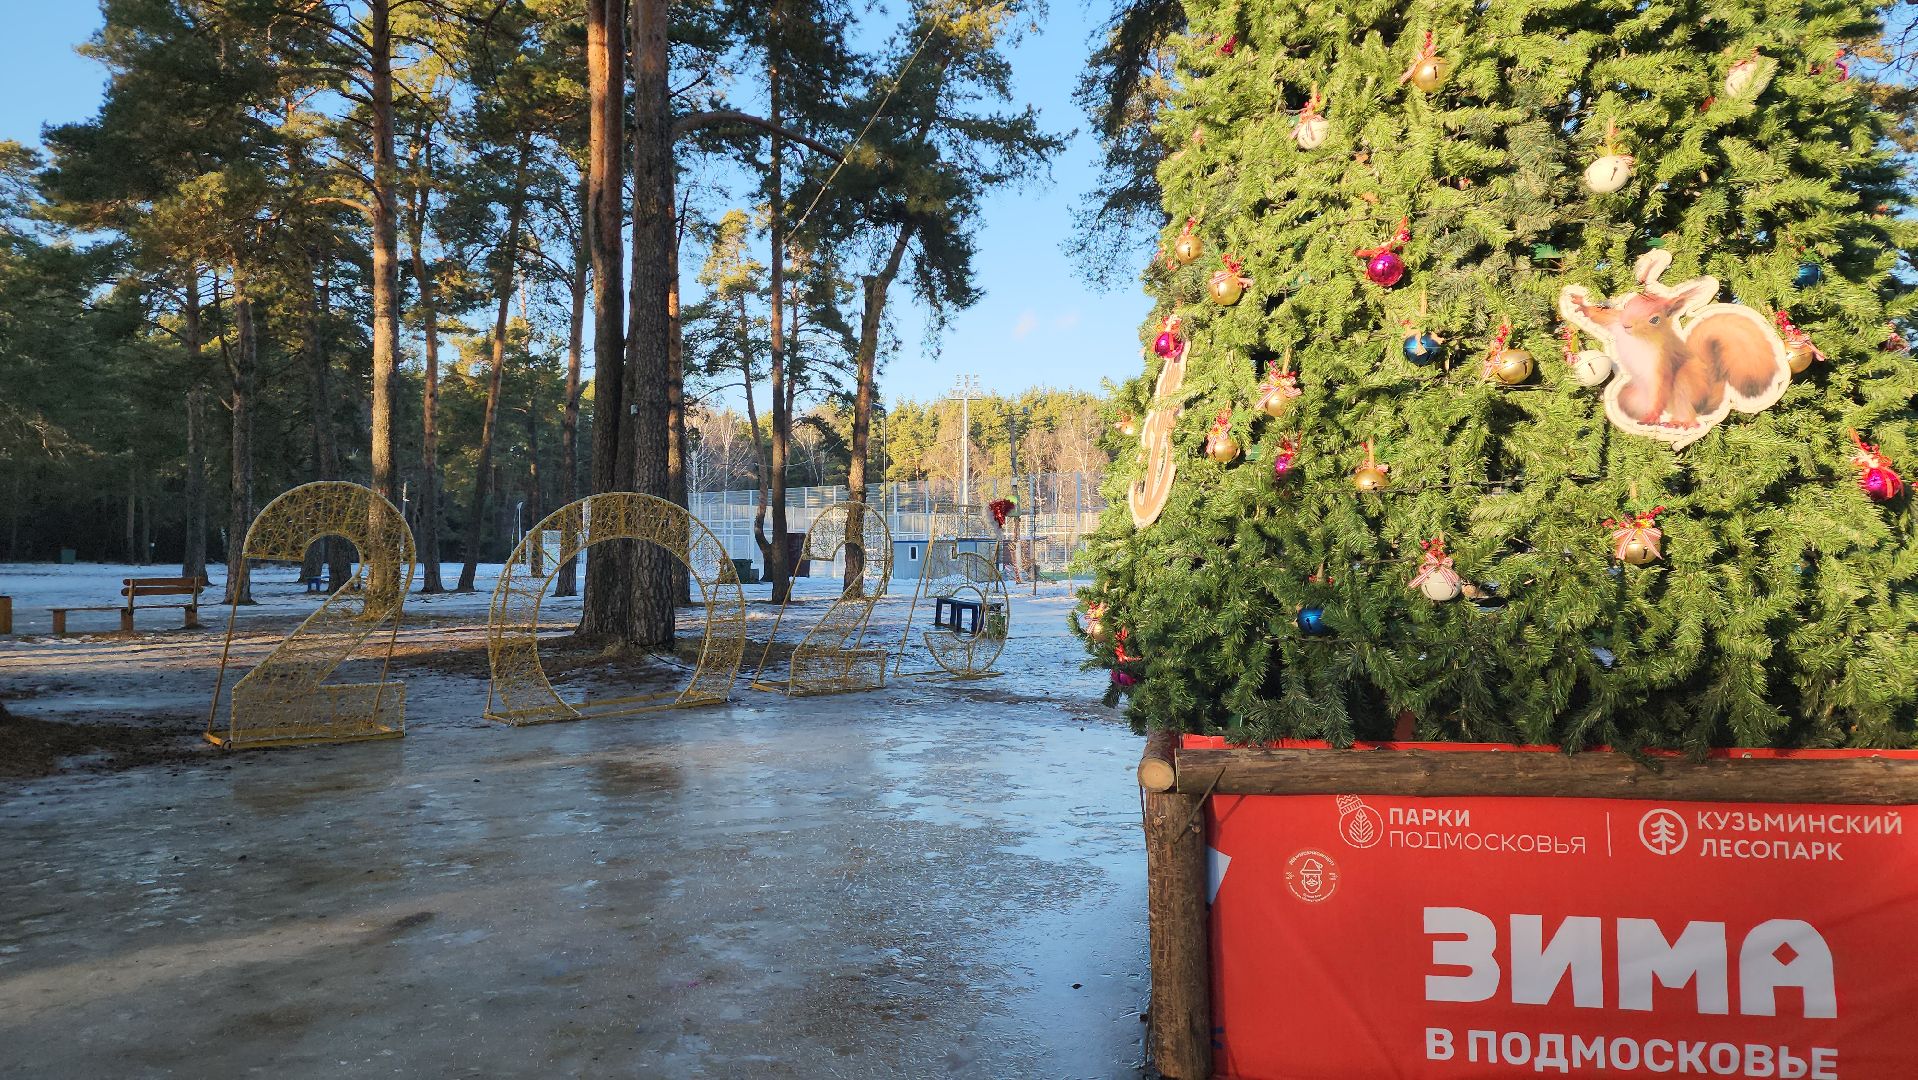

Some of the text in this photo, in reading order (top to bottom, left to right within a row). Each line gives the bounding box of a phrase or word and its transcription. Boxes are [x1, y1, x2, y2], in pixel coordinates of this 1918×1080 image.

[1389, 807, 1470, 827] ПАРКИ
[1697, 811, 1903, 835] КУЗЬМИНСКИЙ
[1389, 830, 1586, 854] ПОДМОСКОВЬЯ
[1700, 838, 1844, 861] ЛЕСОПАРК
[1423, 906, 1838, 1019] ЗИМА
[1425, 1027, 1839, 1080] В ПОДМОСКОВЬЕ
